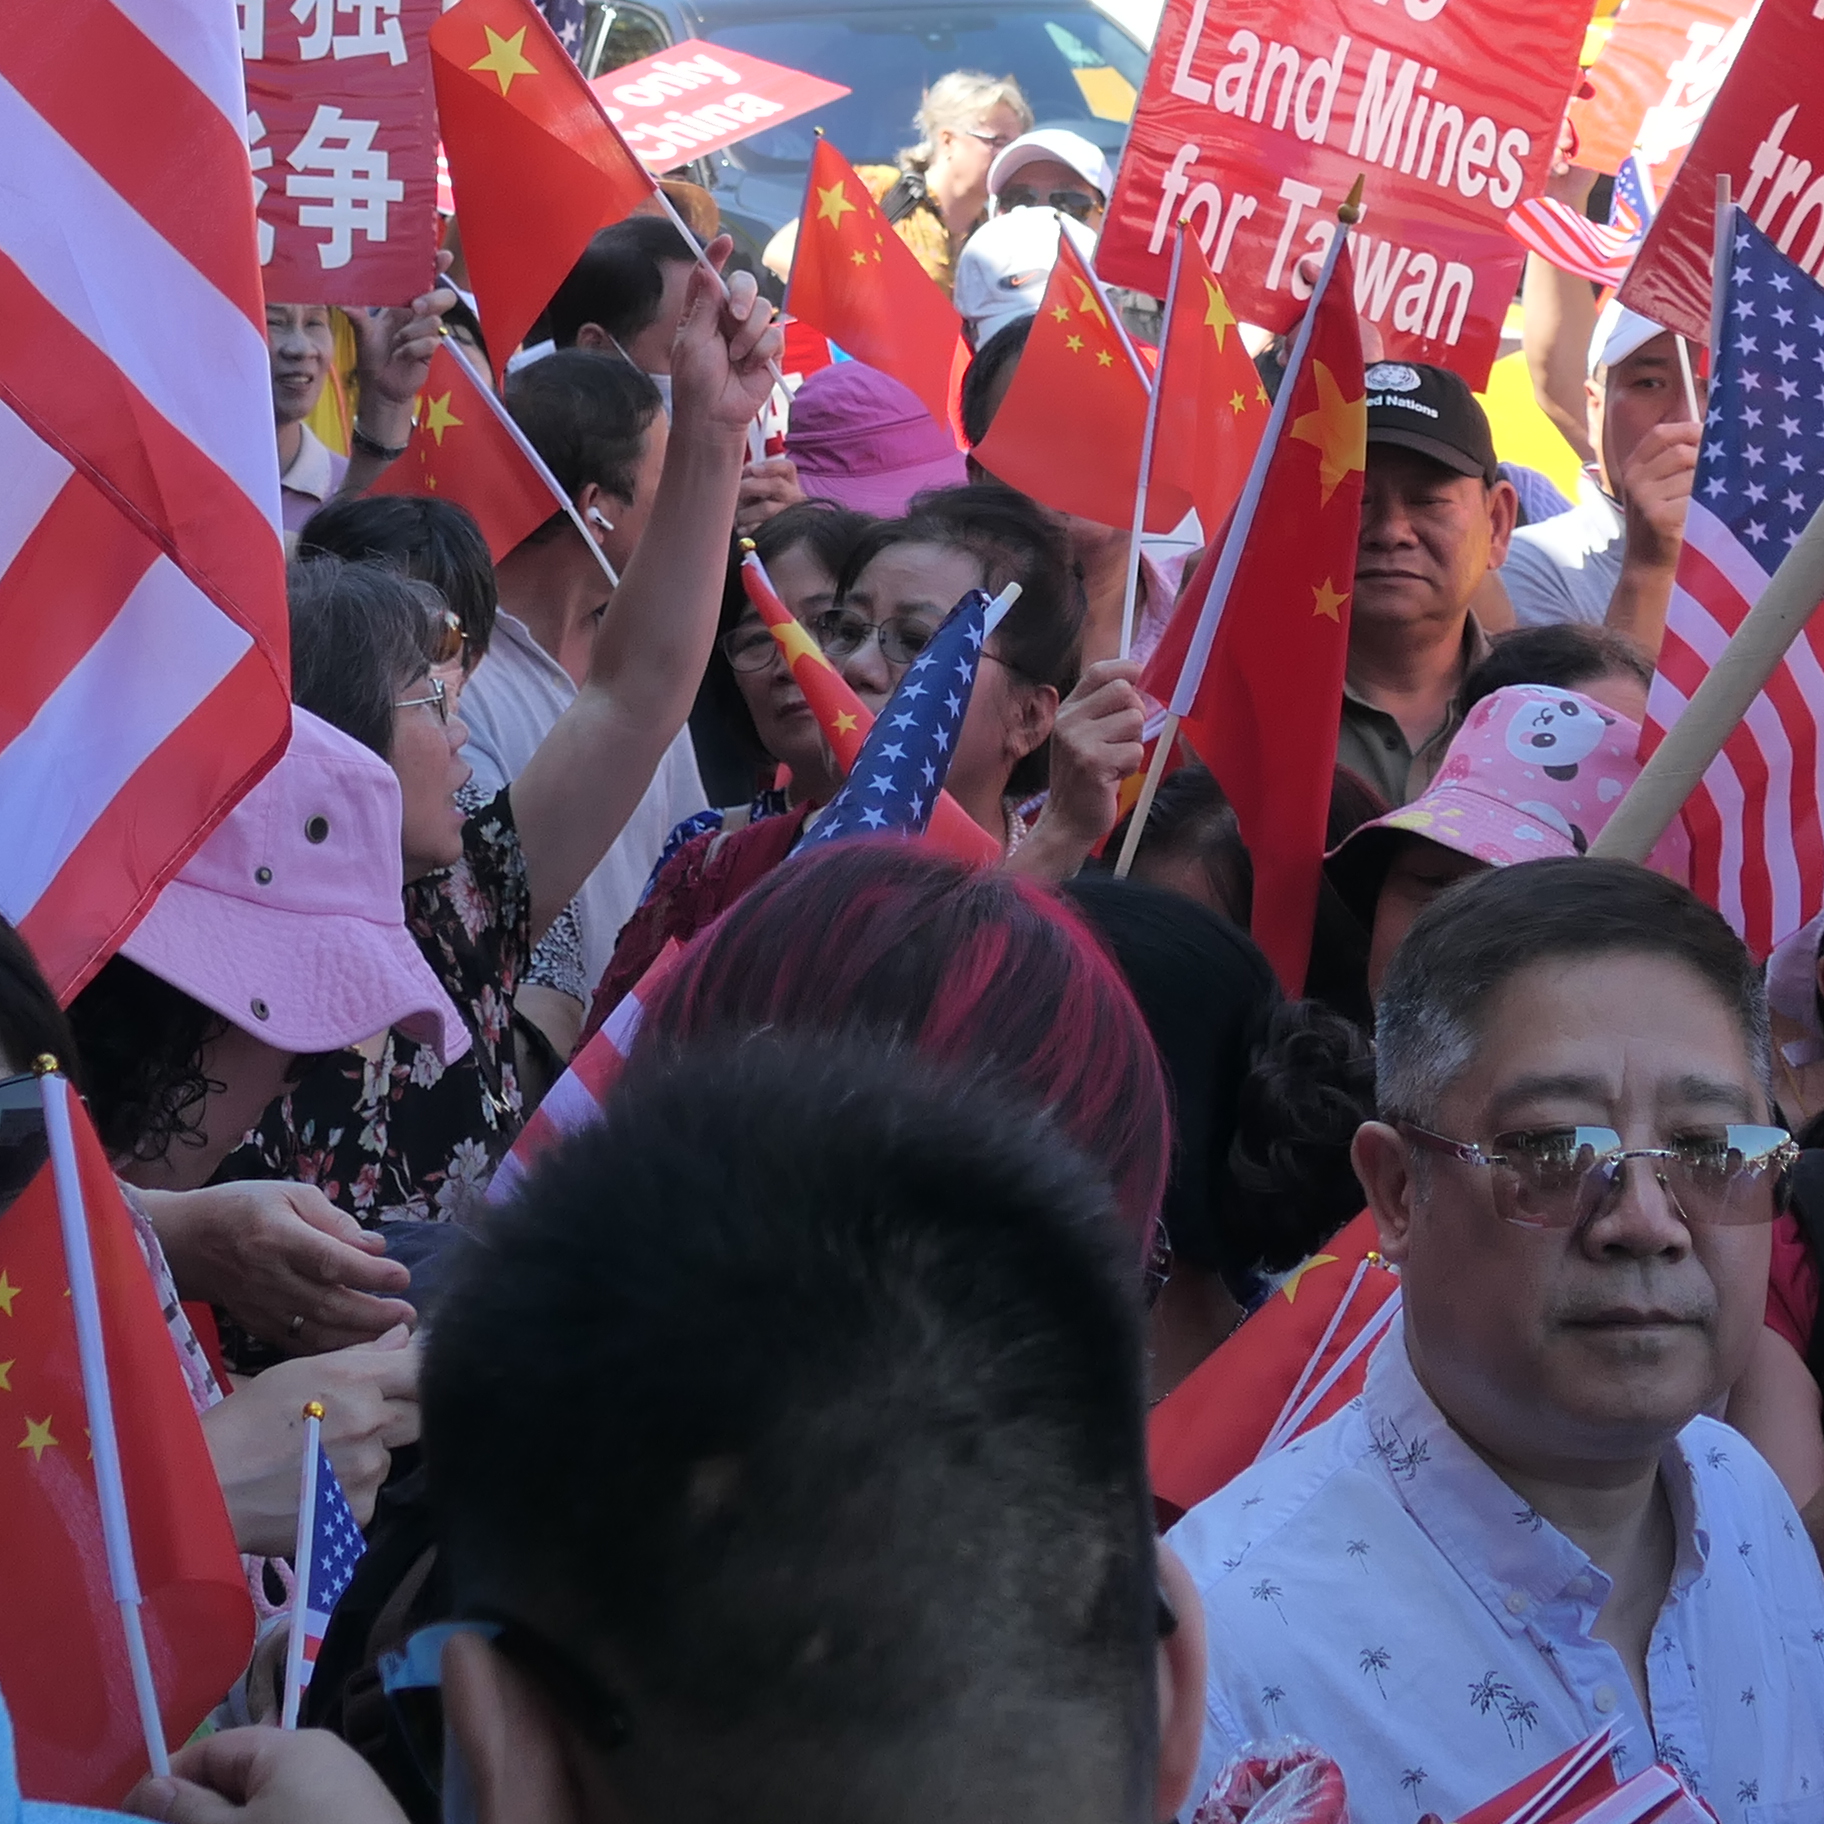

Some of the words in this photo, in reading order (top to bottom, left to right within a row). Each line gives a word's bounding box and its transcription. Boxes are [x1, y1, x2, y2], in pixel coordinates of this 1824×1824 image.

[612, 53, 742, 107] only
[1348, 44, 1531, 210] Mines
[1148, 143, 1259, 275] for
[1385, 394, 1439, 419] Nations
